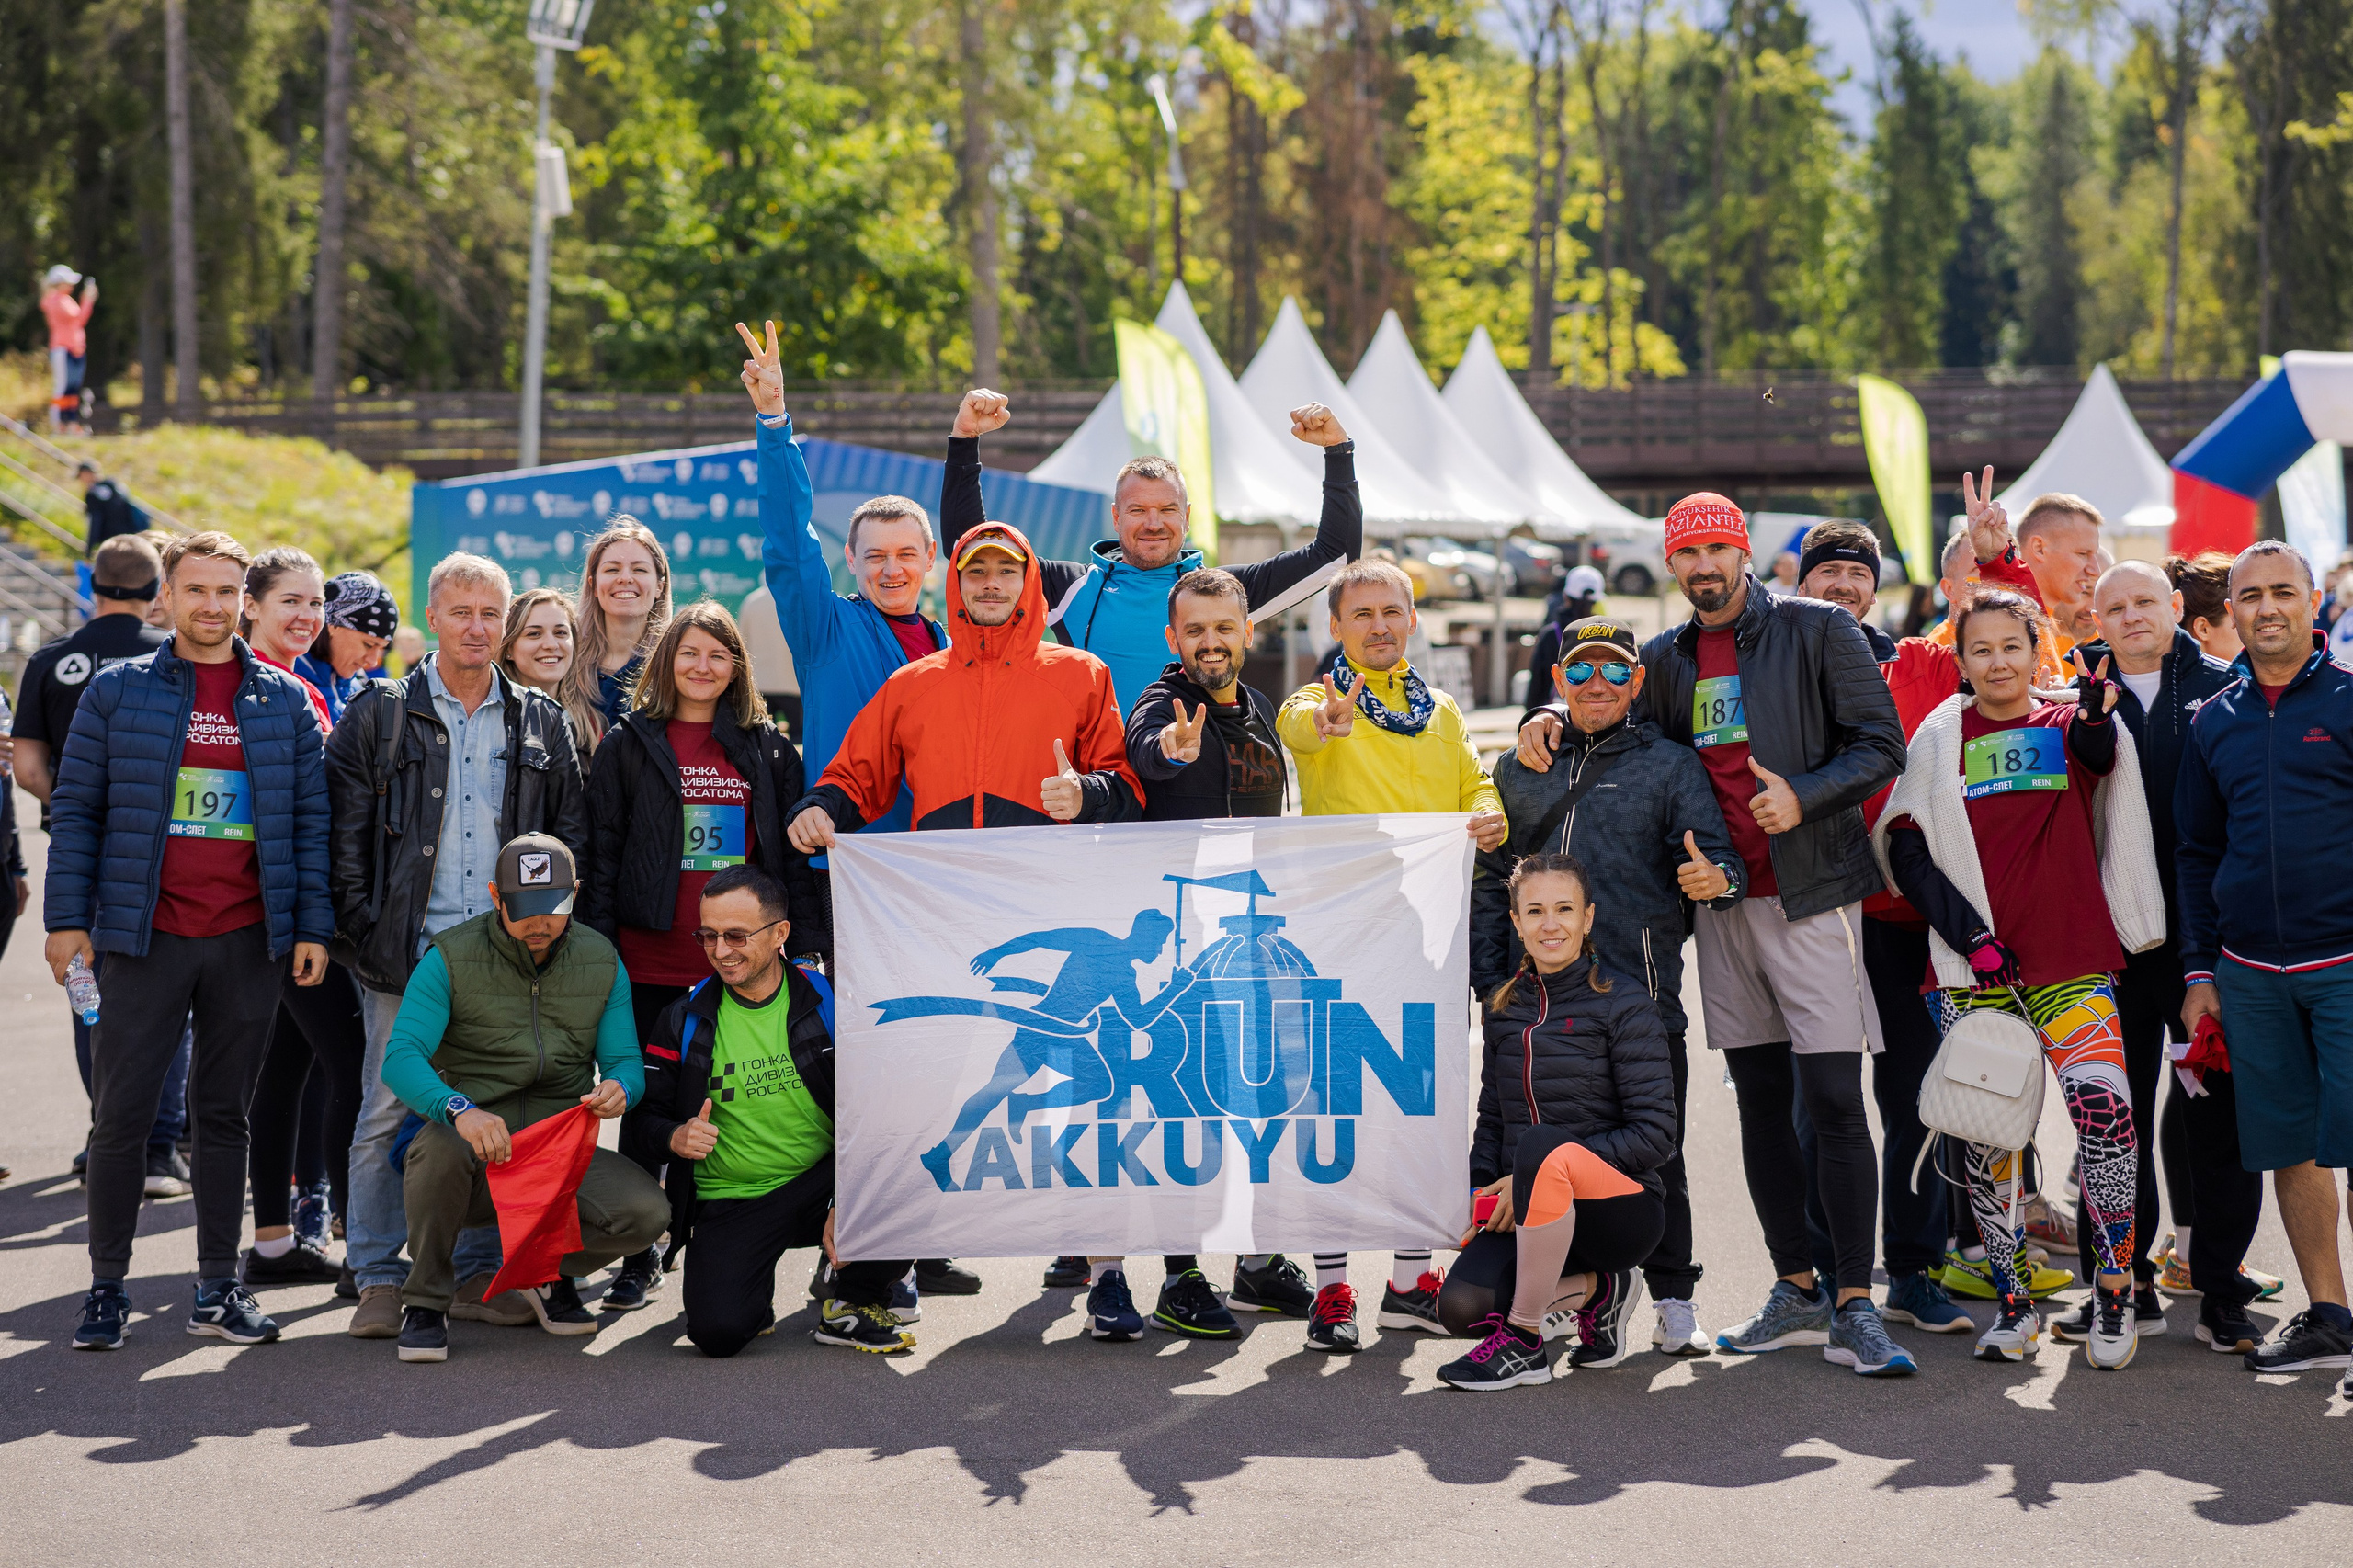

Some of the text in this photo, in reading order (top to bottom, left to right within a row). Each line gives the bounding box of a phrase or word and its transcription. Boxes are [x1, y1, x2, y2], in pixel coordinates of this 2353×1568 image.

[1576, 624, 1618, 641] URBAN
[1699, 696, 1743, 729] 187
[1985, 747, 2042, 776] 182
[2031, 778, 2052, 787] REIN
[184, 790, 237, 818] 197
[223, 828, 243, 837] REIN
[712, 860, 730, 869] REIN
[742, 1053, 790, 1072] ГОНКА
[1097, 1000, 1435, 1119] RUN
[745, 1066, 799, 1087] ДИВИЗ
[746, 1078, 805, 1099] РОСАТО
[962, 1119, 1356, 1191] AKKUYU
[1953, 1260, 1985, 1278] salomon
